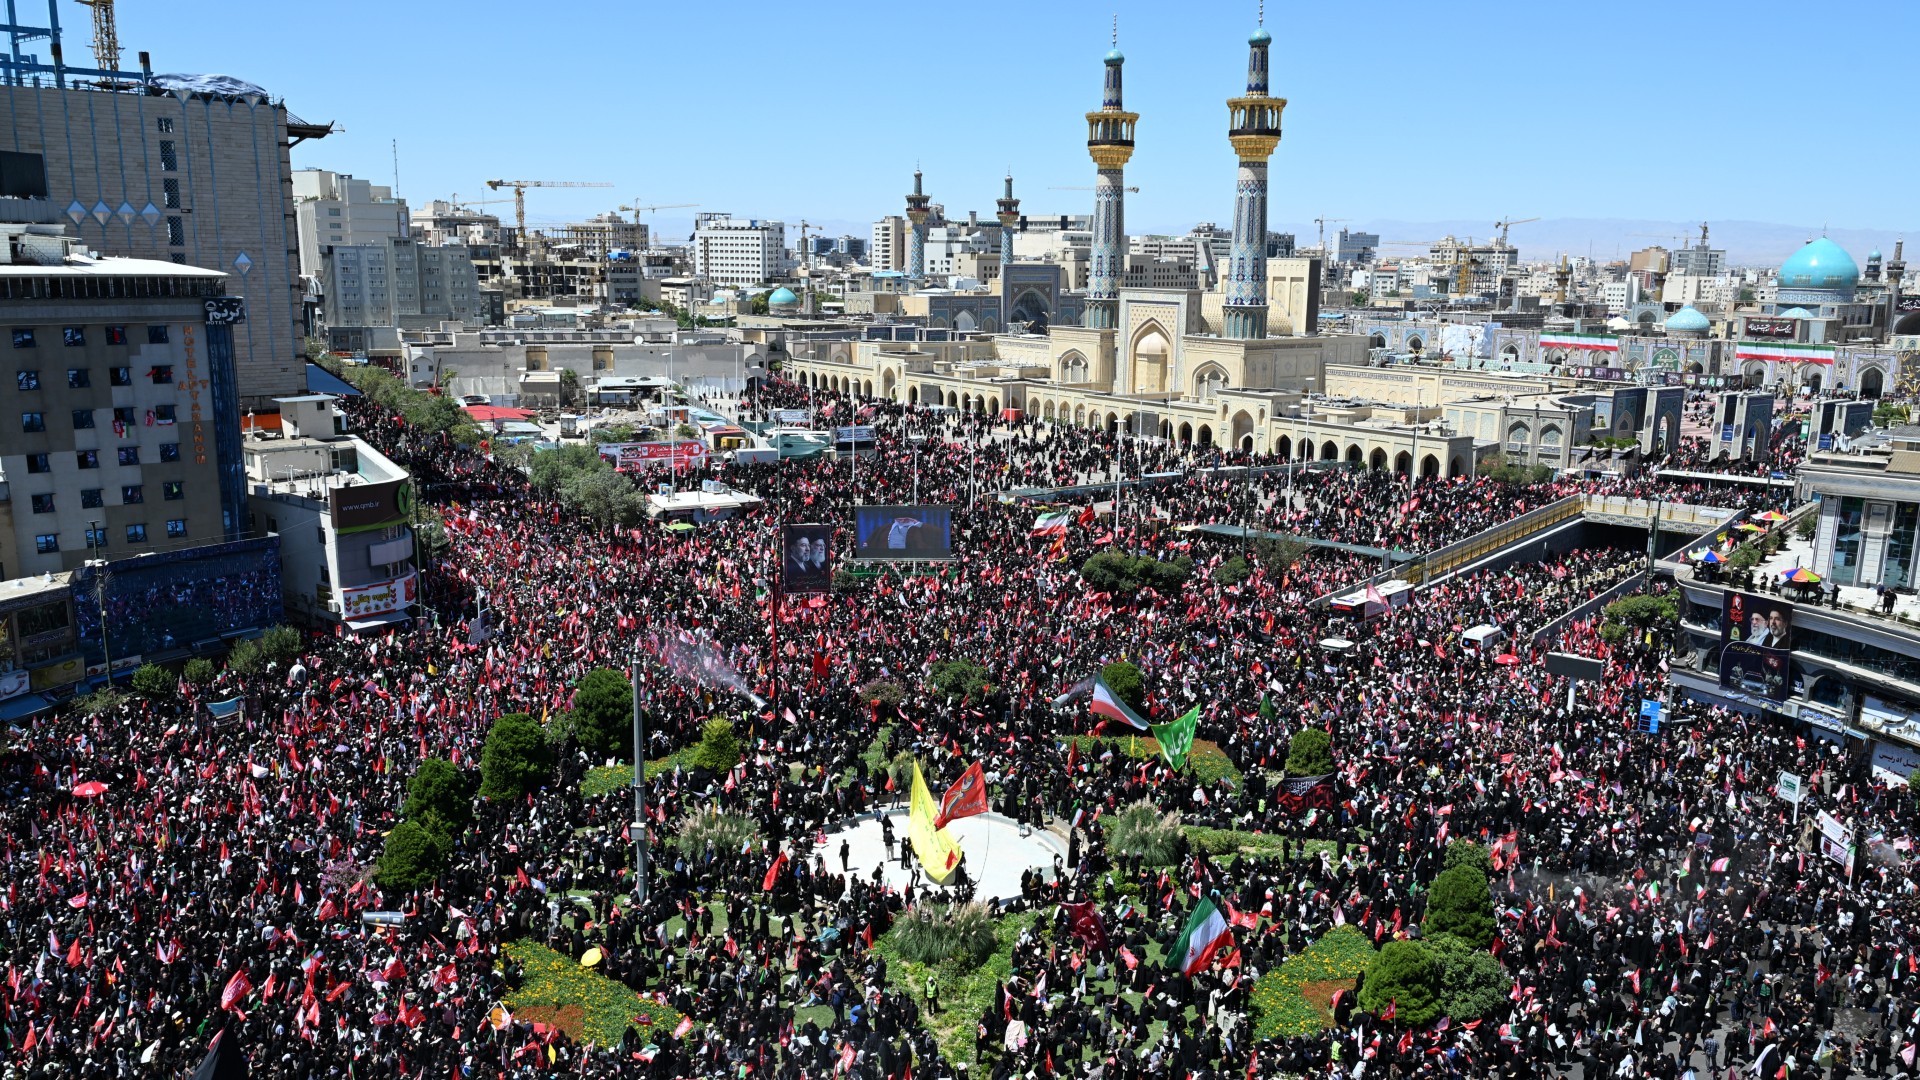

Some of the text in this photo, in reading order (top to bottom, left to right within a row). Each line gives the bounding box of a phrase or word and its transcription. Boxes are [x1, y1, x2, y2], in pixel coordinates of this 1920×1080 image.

[183, 325, 197, 379] HOTEL
[342, 501, 379, 511] www.qmb.ir
[1641, 701, 1651, 712] P
[1879, 753, 1902, 764] ادریس
